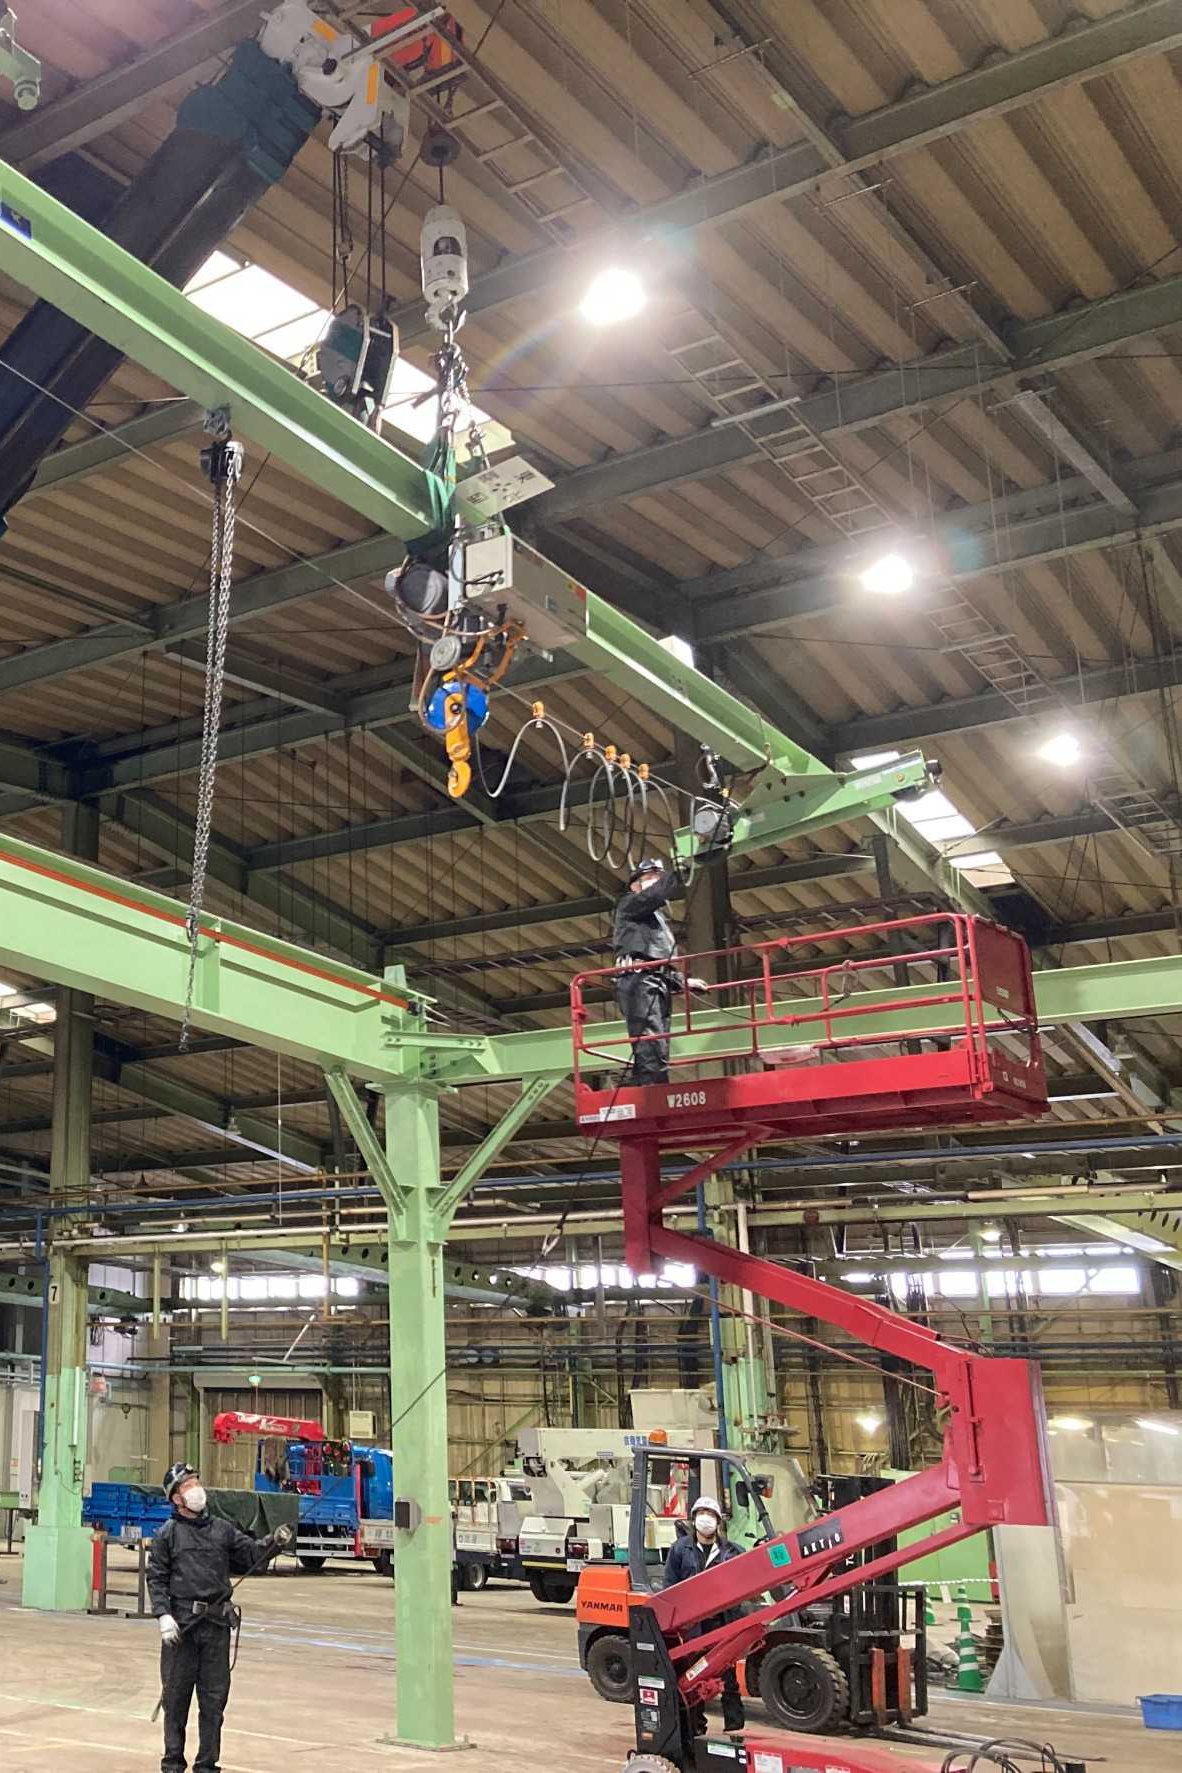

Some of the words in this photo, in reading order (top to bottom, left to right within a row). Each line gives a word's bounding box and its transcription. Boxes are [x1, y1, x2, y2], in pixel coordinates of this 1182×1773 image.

[666, 1091, 707, 1108] W2608
[50, 1285, 58, 1302] 7
[581, 1600, 623, 1613] YANMAR
